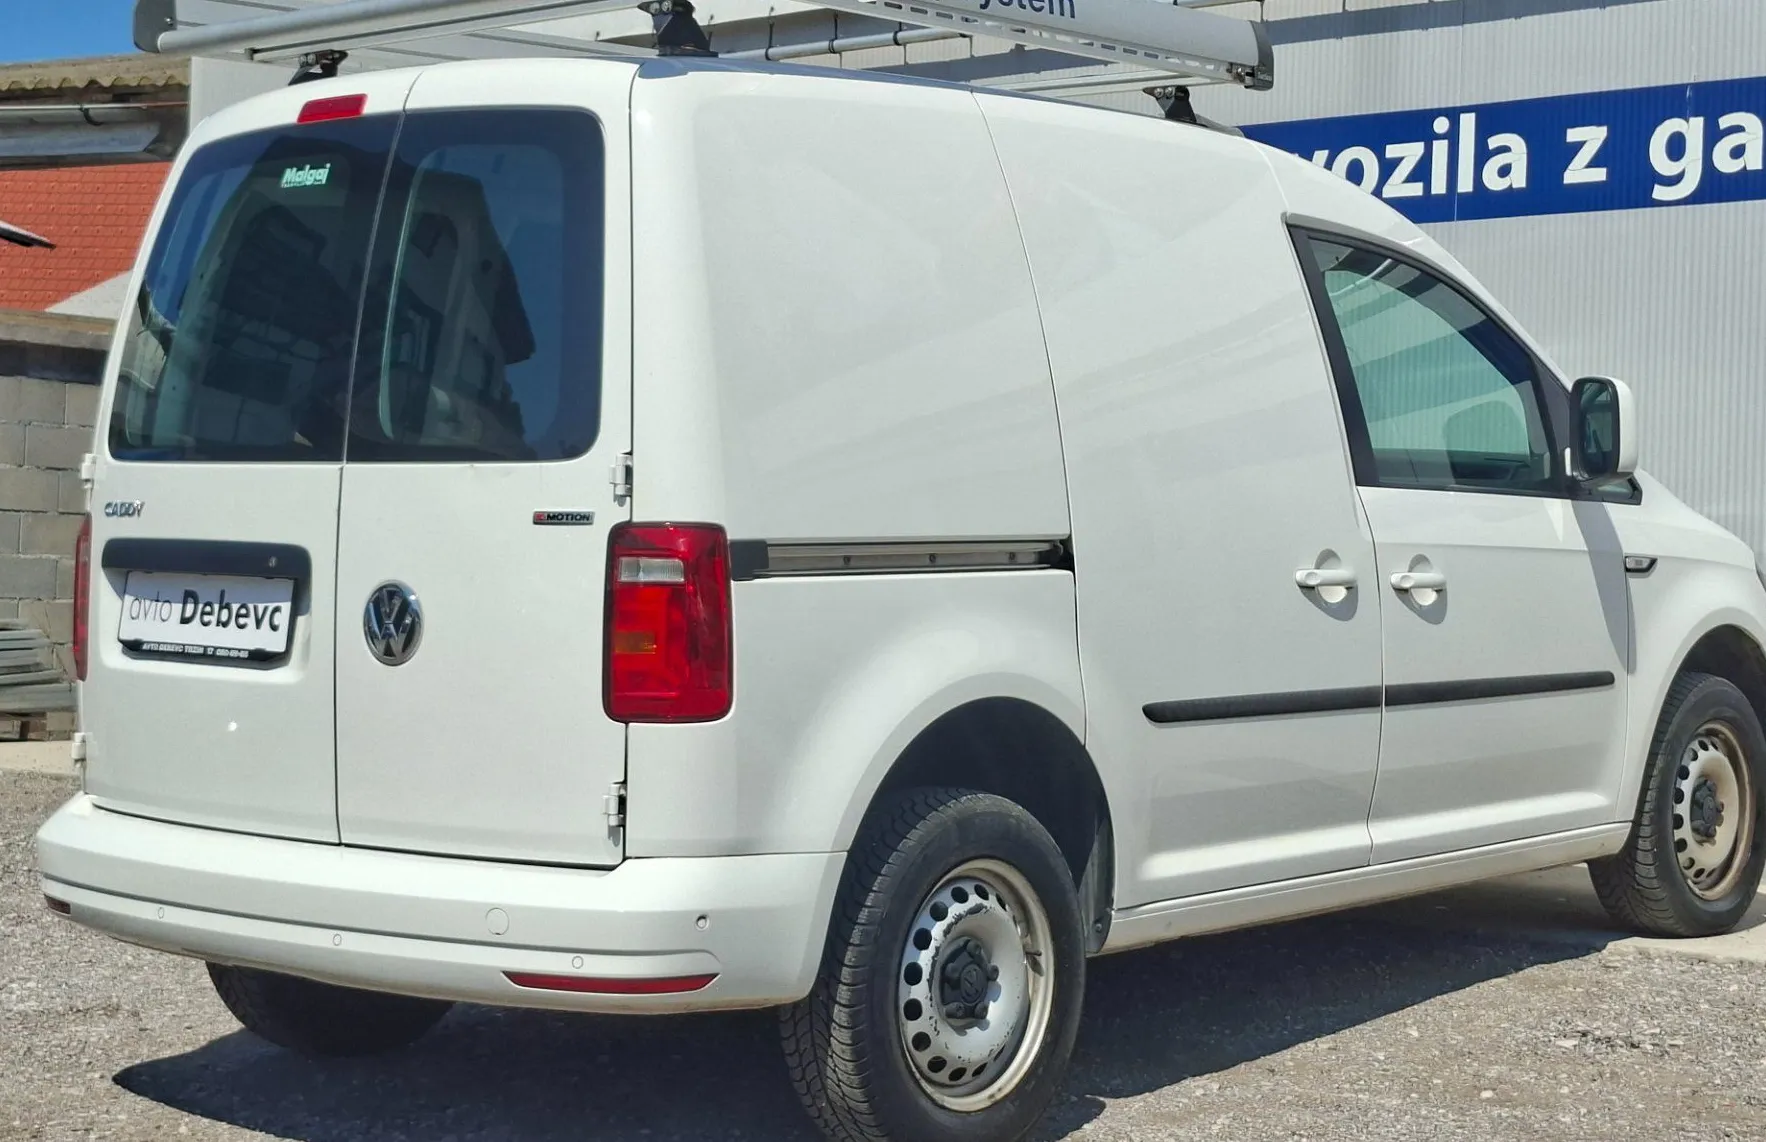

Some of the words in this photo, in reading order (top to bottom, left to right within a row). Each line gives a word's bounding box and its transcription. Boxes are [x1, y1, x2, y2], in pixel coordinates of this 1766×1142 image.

[1563, 125, 1608, 184] z
[1648, 111, 1764, 201] ga
[104, 501, 145, 518] CADDY
[129, 590, 173, 622] avto
[179, 589, 283, 632] Debevc
